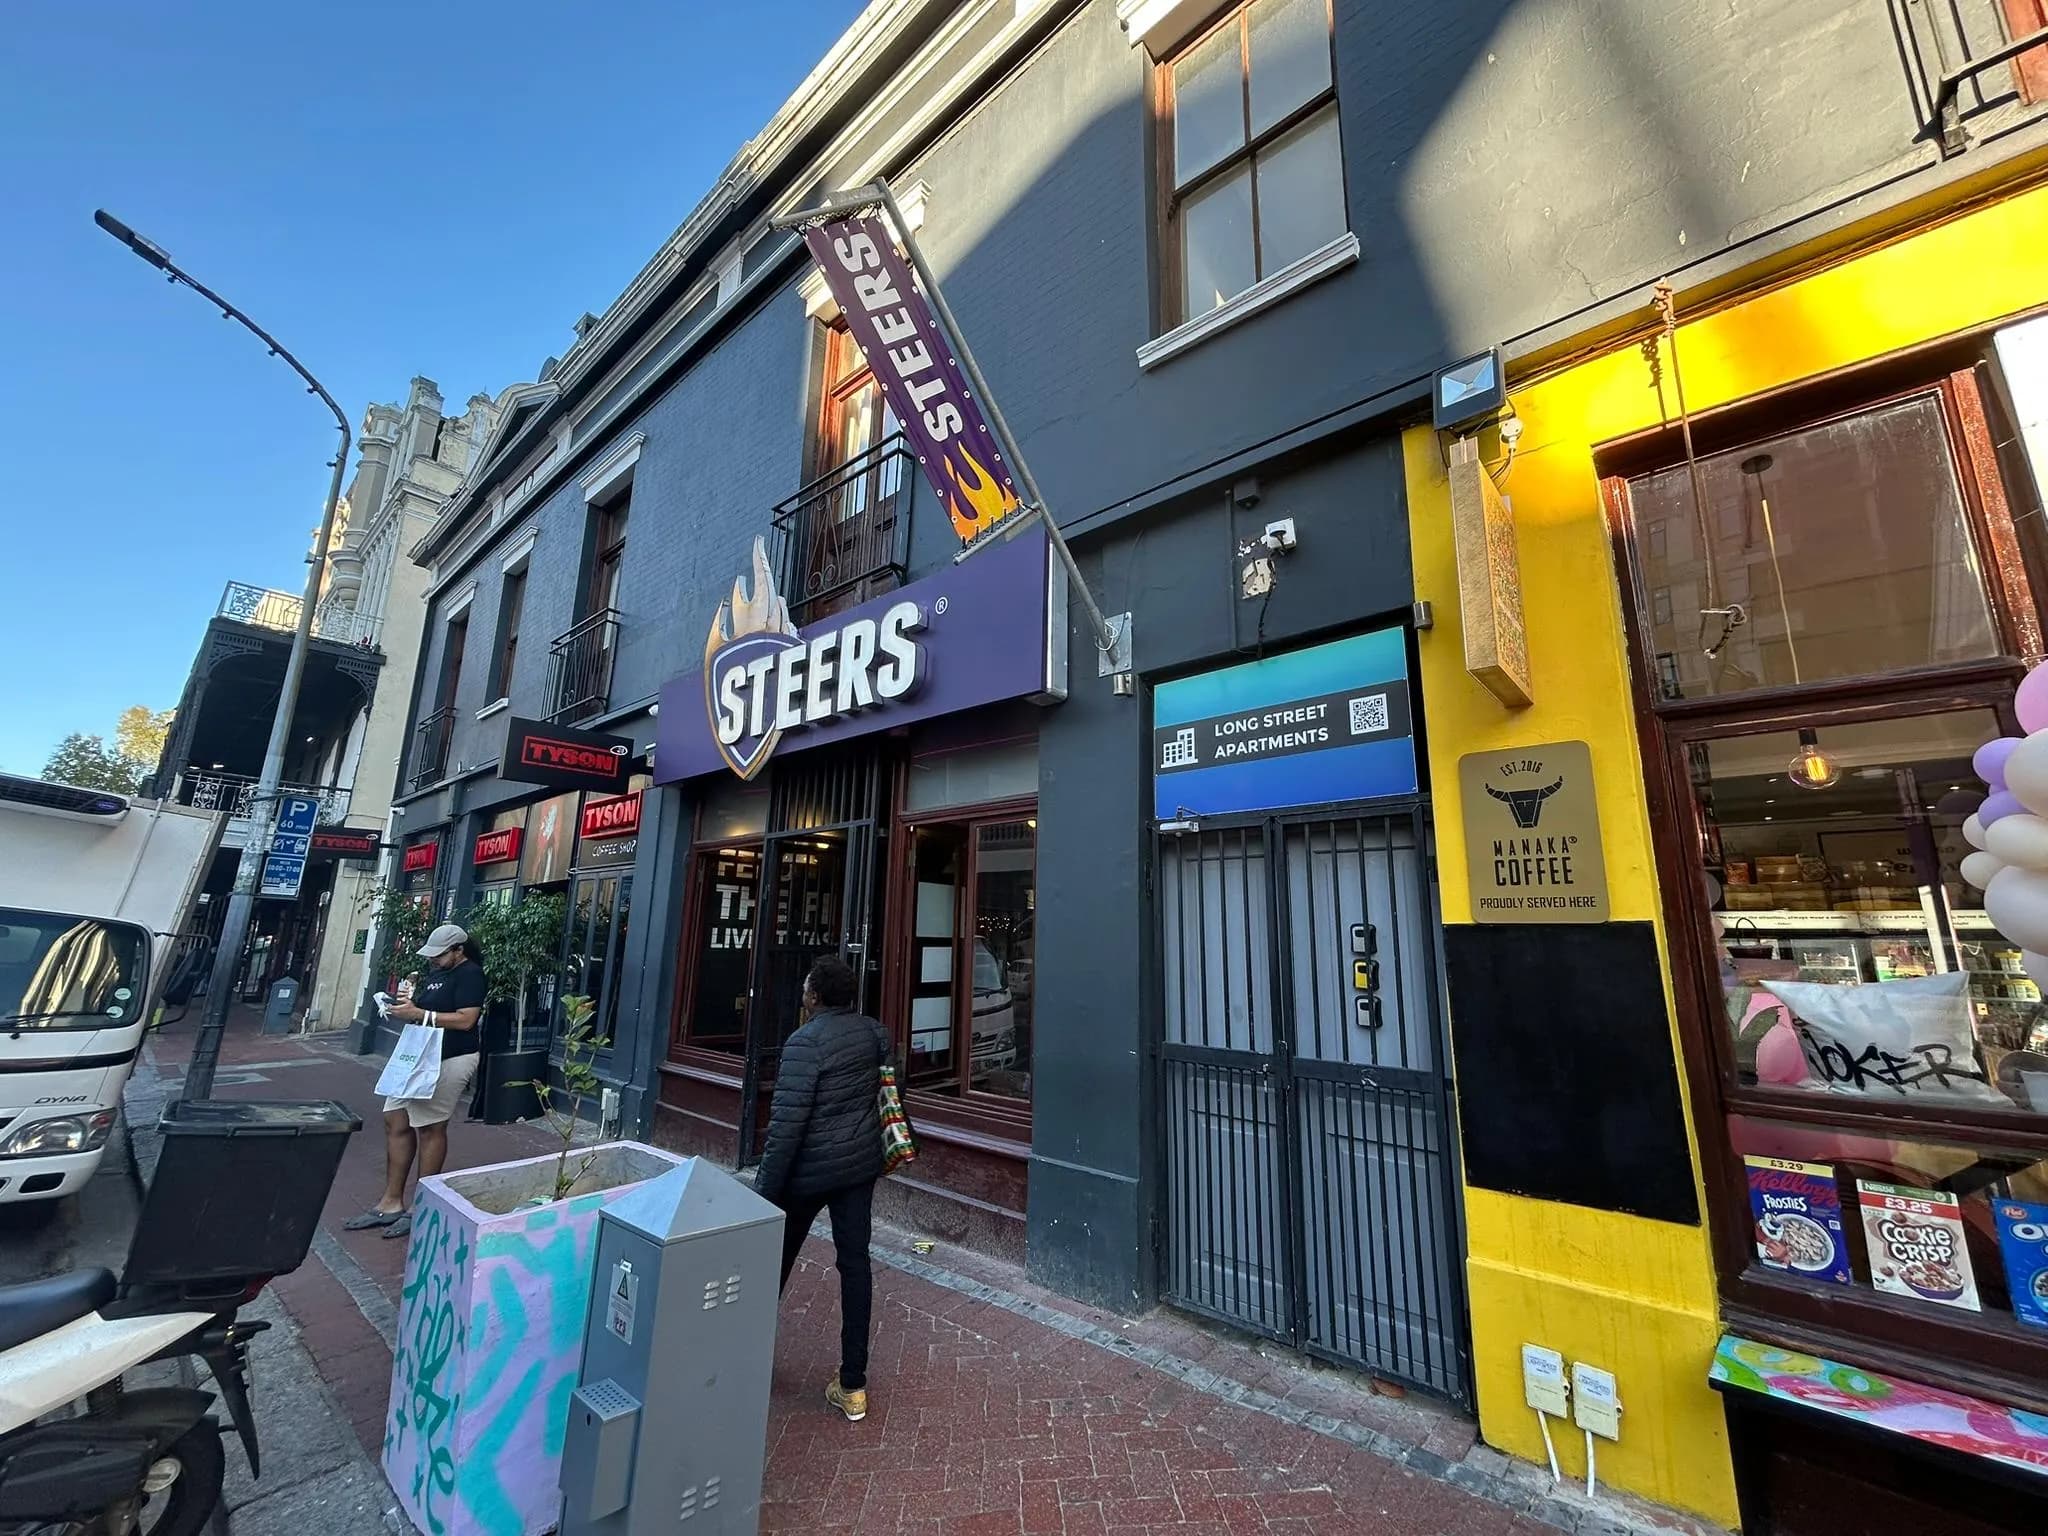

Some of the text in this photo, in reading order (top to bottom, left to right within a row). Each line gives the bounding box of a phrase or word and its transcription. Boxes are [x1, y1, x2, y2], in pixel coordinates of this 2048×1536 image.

[833, 231, 963, 443] STEERS
[718, 601, 919, 745] STEERS
[1214, 703, 1328, 738] LONG STREET
[1214, 726, 1329, 760] APARTMENTS
[530, 742, 614, 771] TYSON
[289, 800, 309, 817] P
[586, 798, 637, 829] TYSON
[280, 819, 294, 829] 60
[478, 834, 510, 857] TYSON
[592, 843, 619, 857] COFFEE
[1494, 856, 1575, 887] COFFEE
[1480, 895, 1597, 909] PROUDLY SERVED HERE
[1797, 1020, 1986, 1096] JOKER
[34, 1095, 88, 1104] DYNA
[1770, 1159, 1804, 1171] £3.29
[1762, 1193, 1808, 1212] FROSTIES
[1884, 1197, 1933, 1215] £3.25
